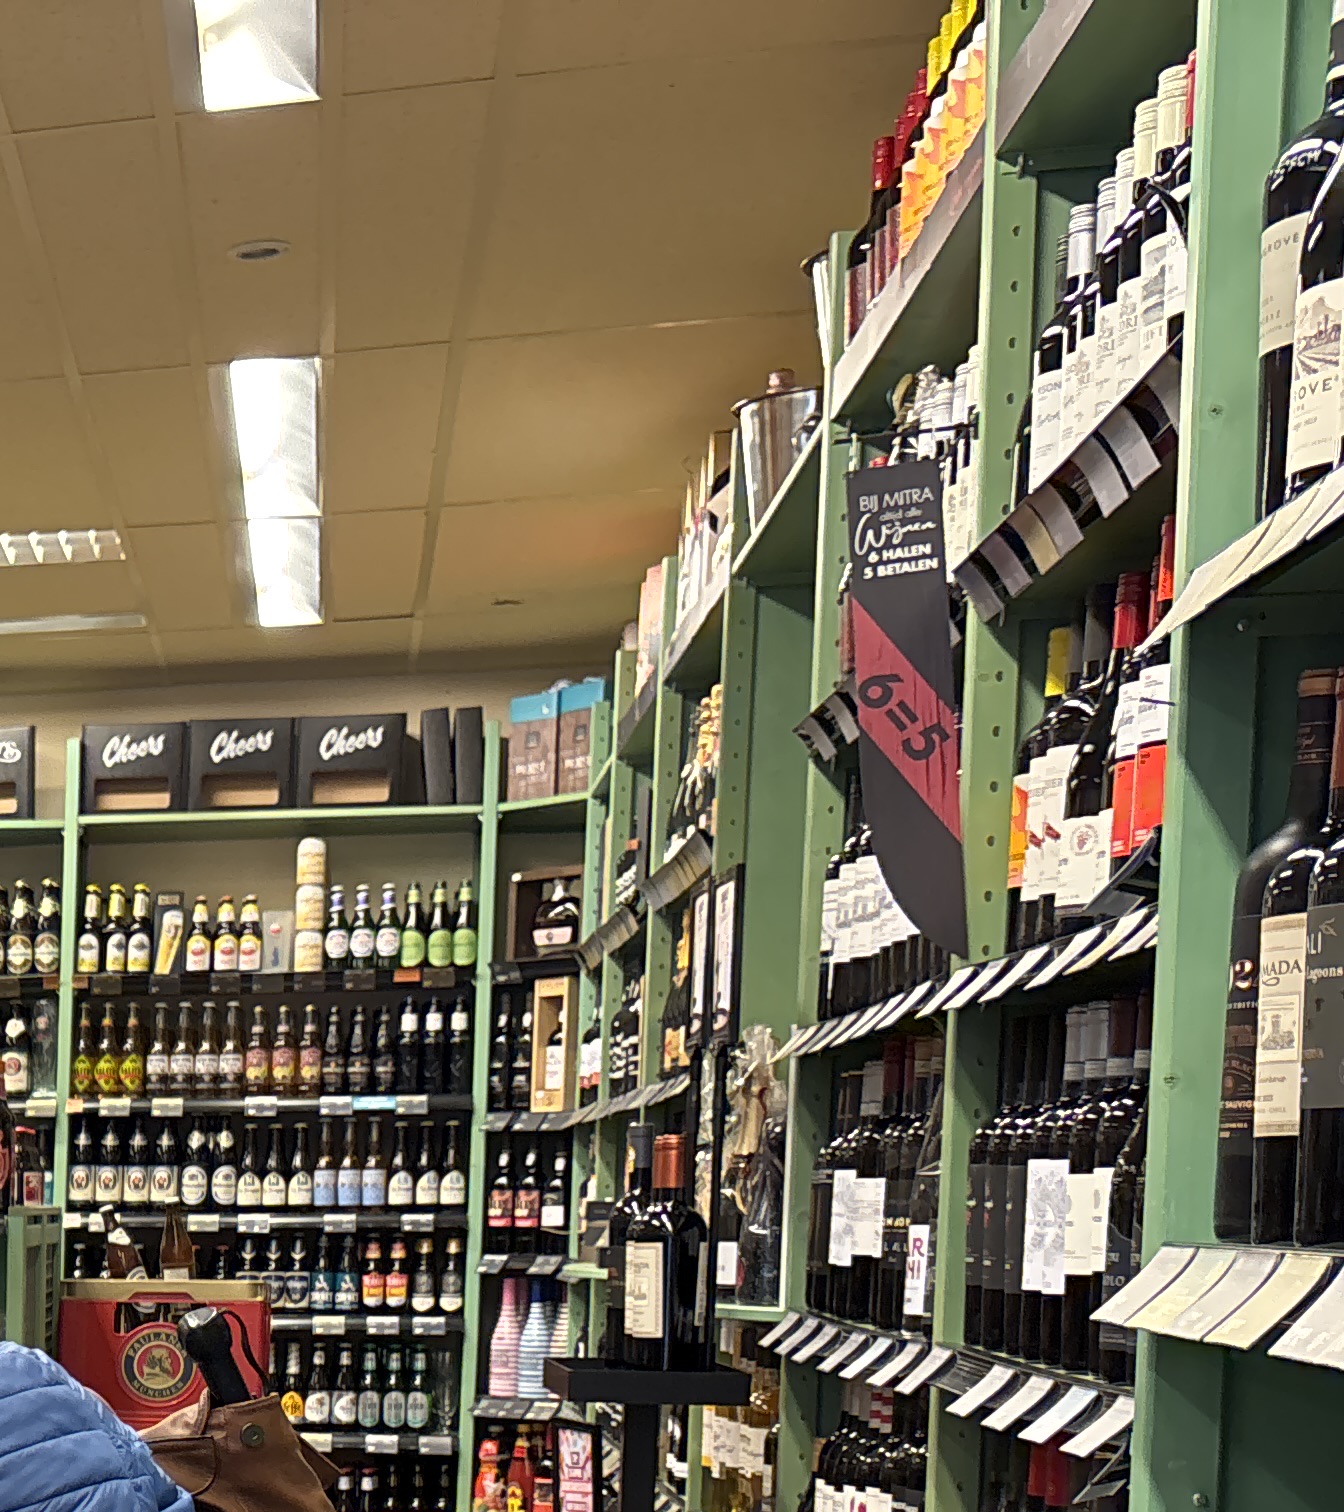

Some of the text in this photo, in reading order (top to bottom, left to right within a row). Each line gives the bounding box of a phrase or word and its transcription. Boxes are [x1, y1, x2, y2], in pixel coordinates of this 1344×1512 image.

[859, 486, 934, 512] BIJ MITRA
[854, 512, 937, 556] Wijnen
[863, 557, 939, 580] 5 BETALEN
[867, 543, 931, 563] 6 HALEN
[858, 673, 950, 761] 6=5
[102, 731, 166, 767] Cheers
[209, 728, 274, 764] Cheers
[319, 725, 385, 761] Cheers
